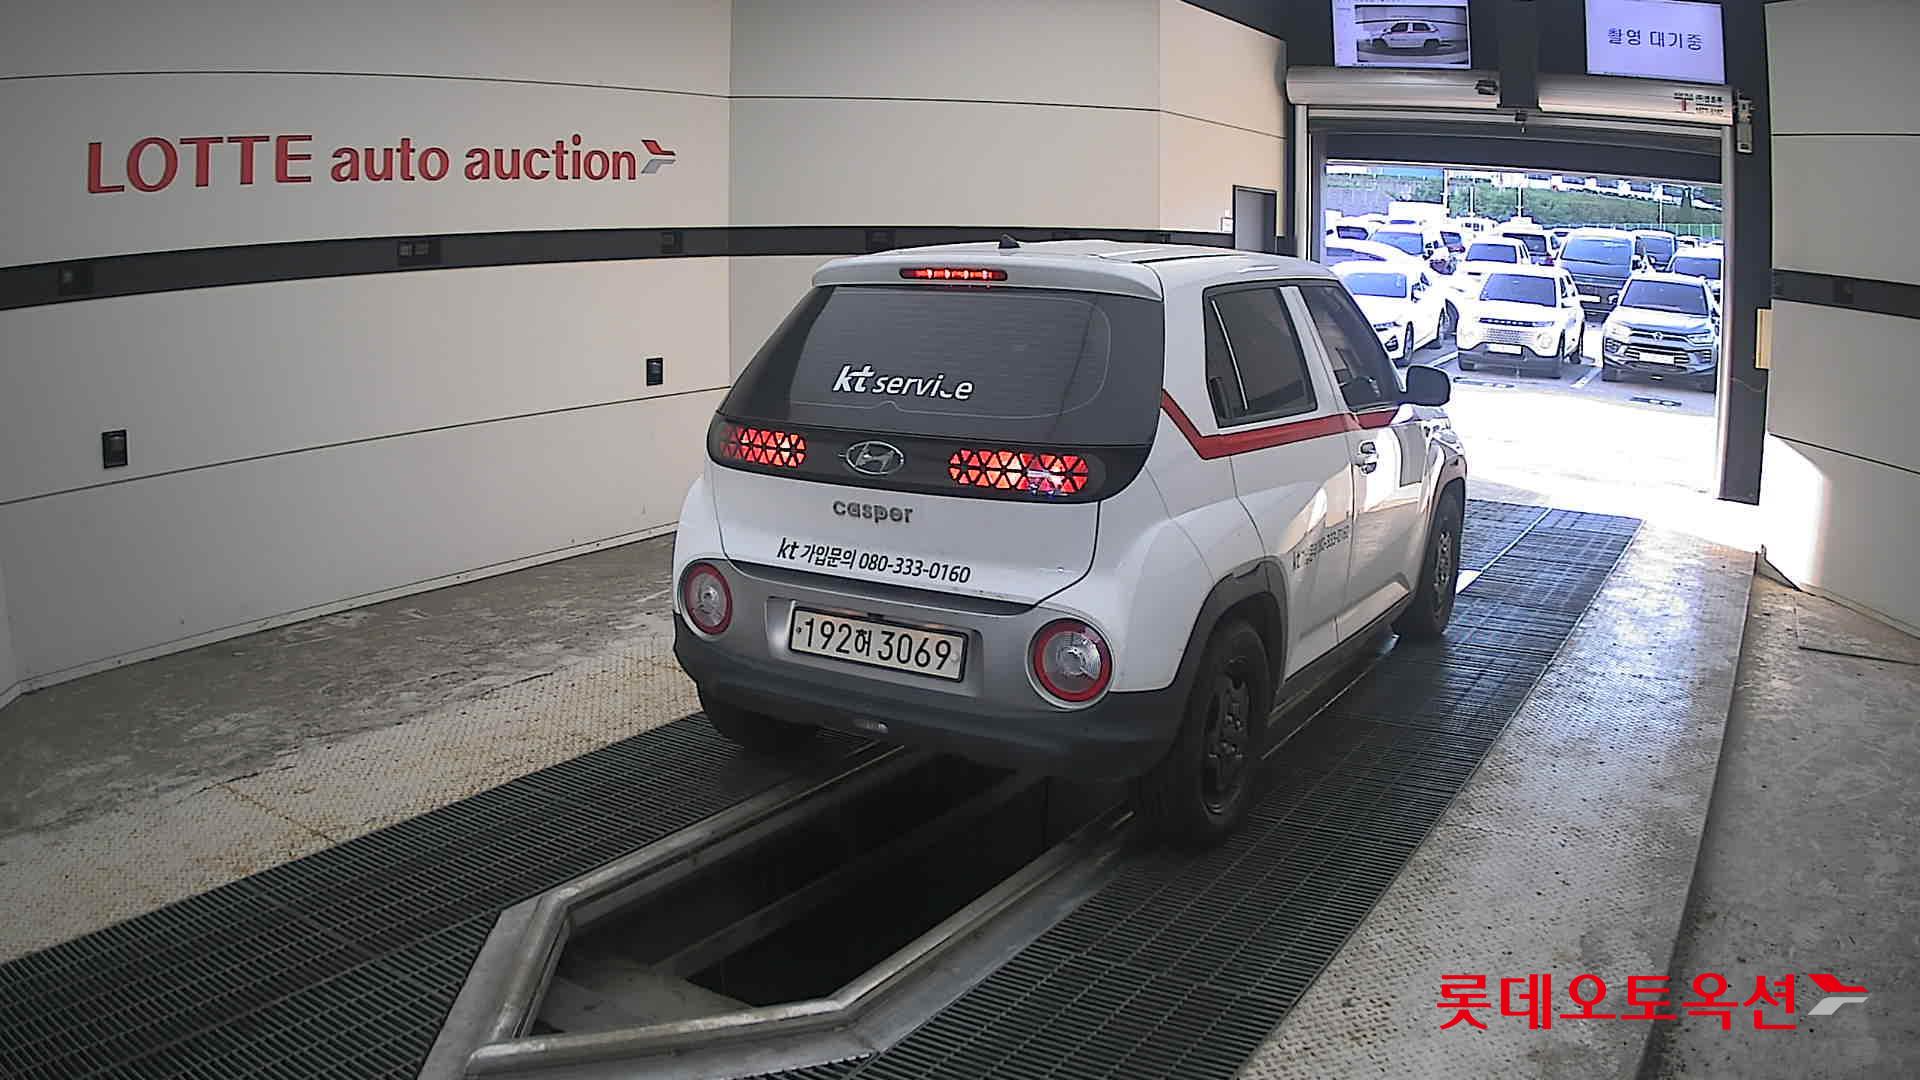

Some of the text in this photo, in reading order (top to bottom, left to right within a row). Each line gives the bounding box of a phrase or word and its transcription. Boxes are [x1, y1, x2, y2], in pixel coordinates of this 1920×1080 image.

[1608, 28, 1641, 45] 촬영
[88, 134, 638, 193] LOTTE auto auction
[832, 365, 875, 392] kt
[832, 500, 913, 523] casper
[776, 538, 971, 583] kt 가입문의 080-333-0160
